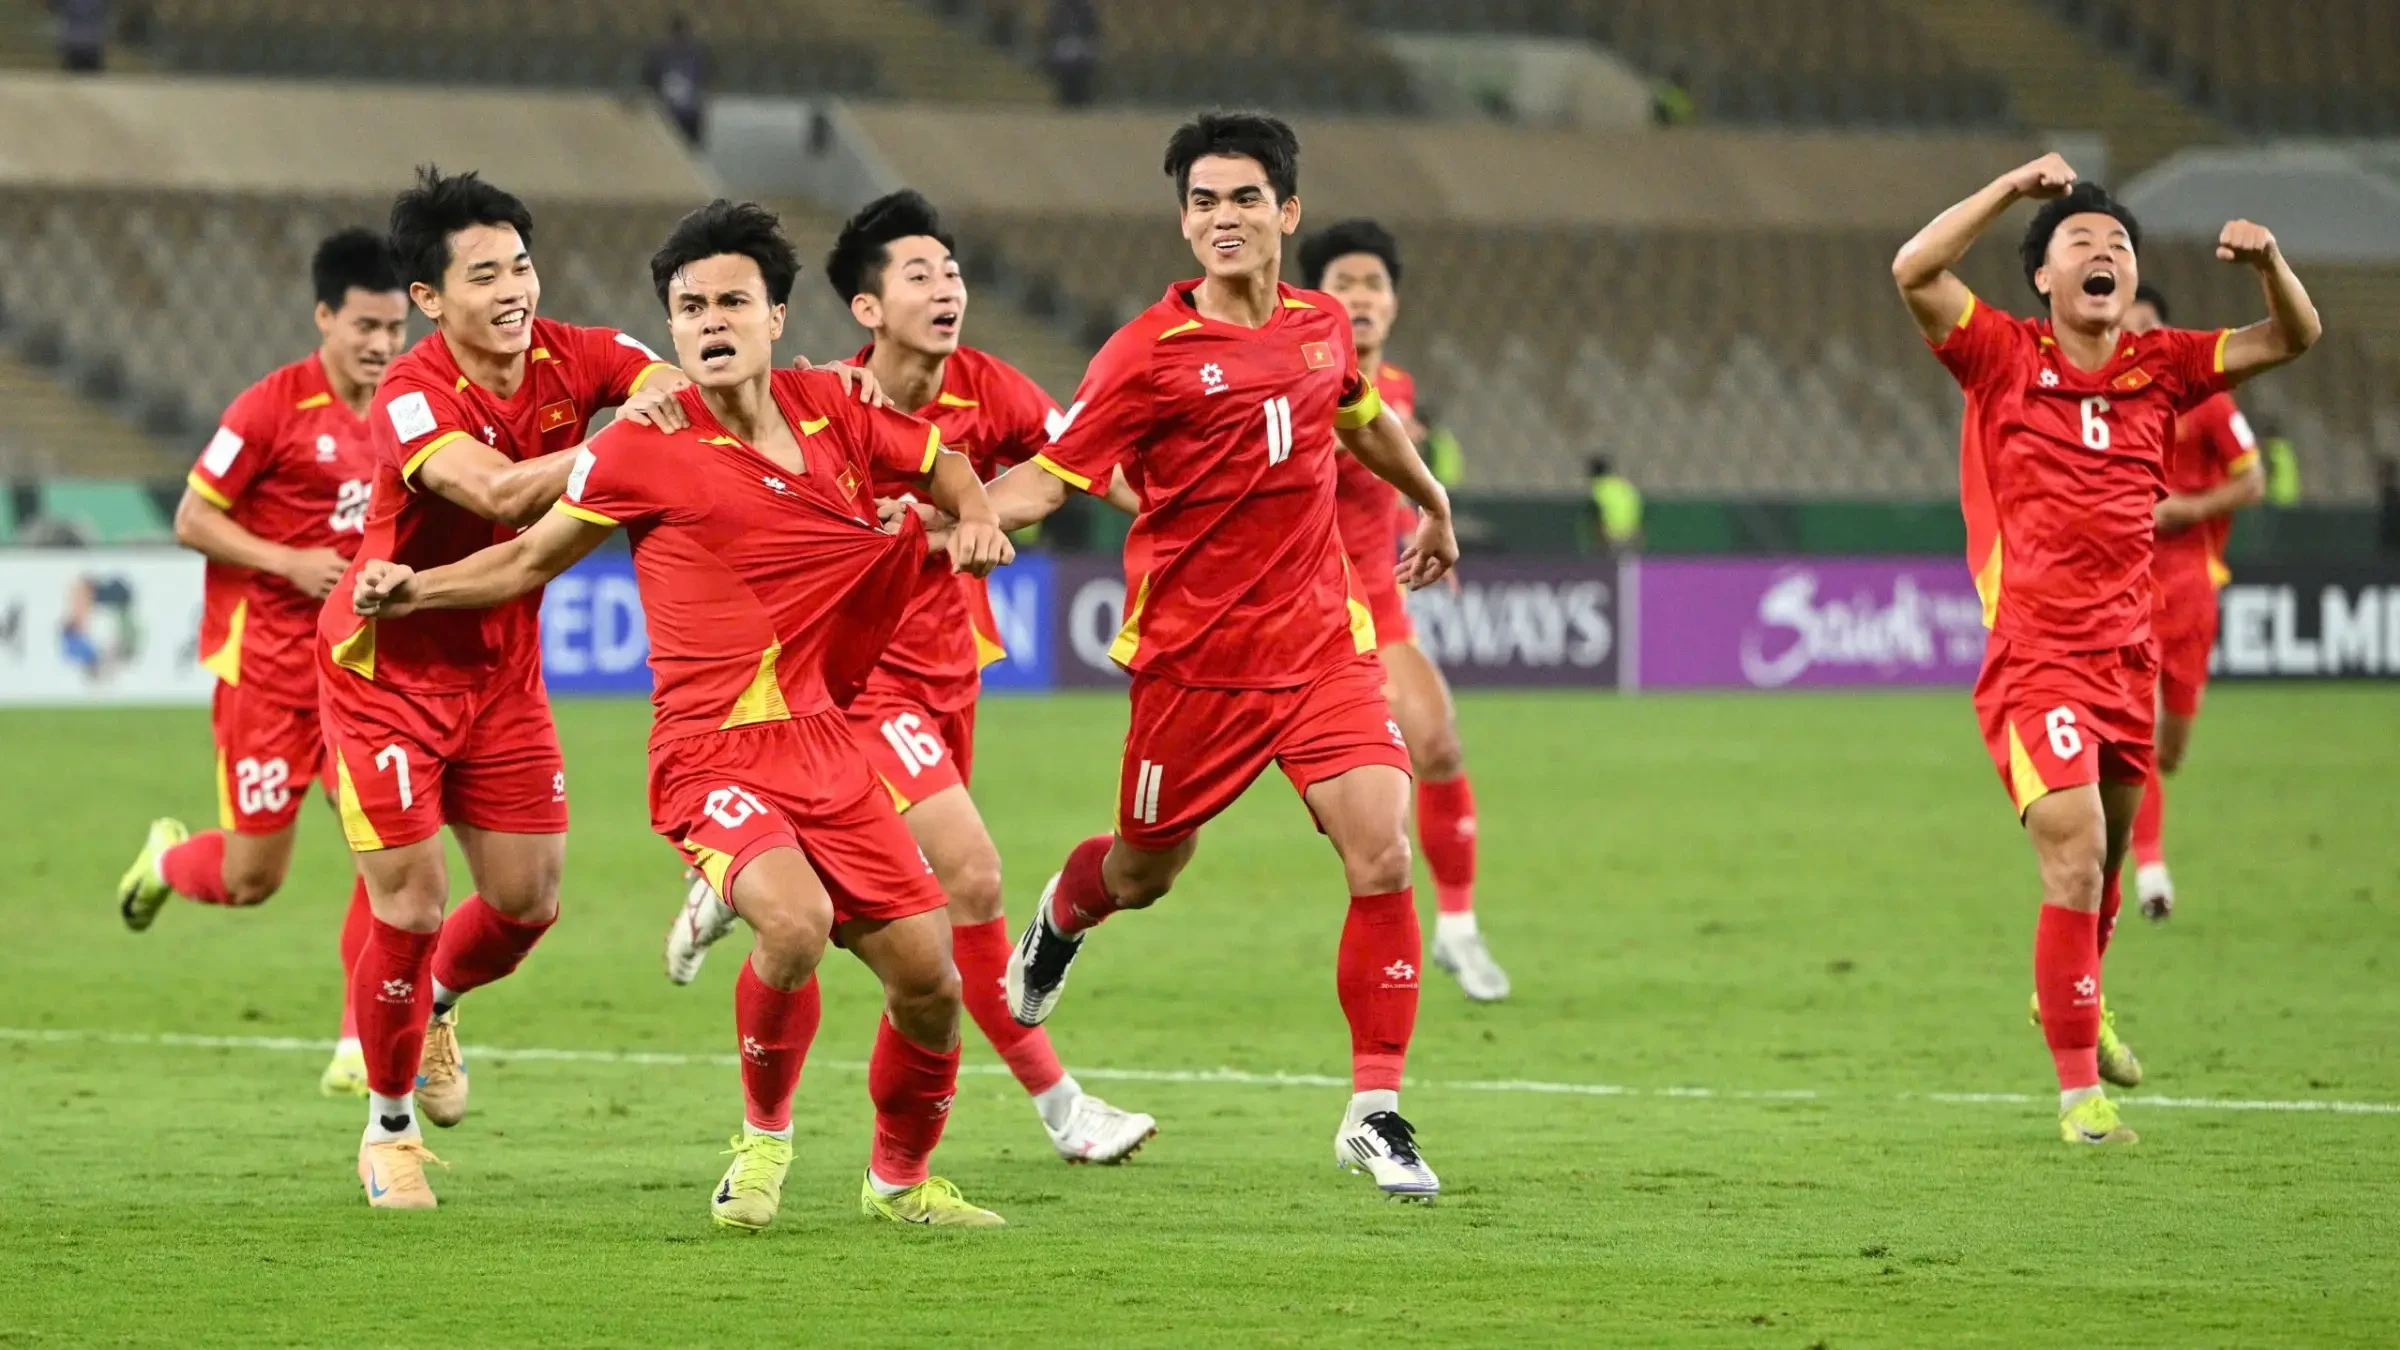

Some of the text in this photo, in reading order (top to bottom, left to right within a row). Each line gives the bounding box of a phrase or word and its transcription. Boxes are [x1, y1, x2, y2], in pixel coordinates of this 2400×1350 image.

[1264, 396, 1293, 467] 11
[2081, 396, 2110, 450] 6
[2208, 583, 2400, 675] ELM
[880, 711, 943, 778] 16
[2045, 705, 2083, 760] 6
[235, 757, 290, 816] 22
[375, 743, 413, 813] 7
[703, 785, 768, 829] 21
[1133, 759, 1164, 824] 11
